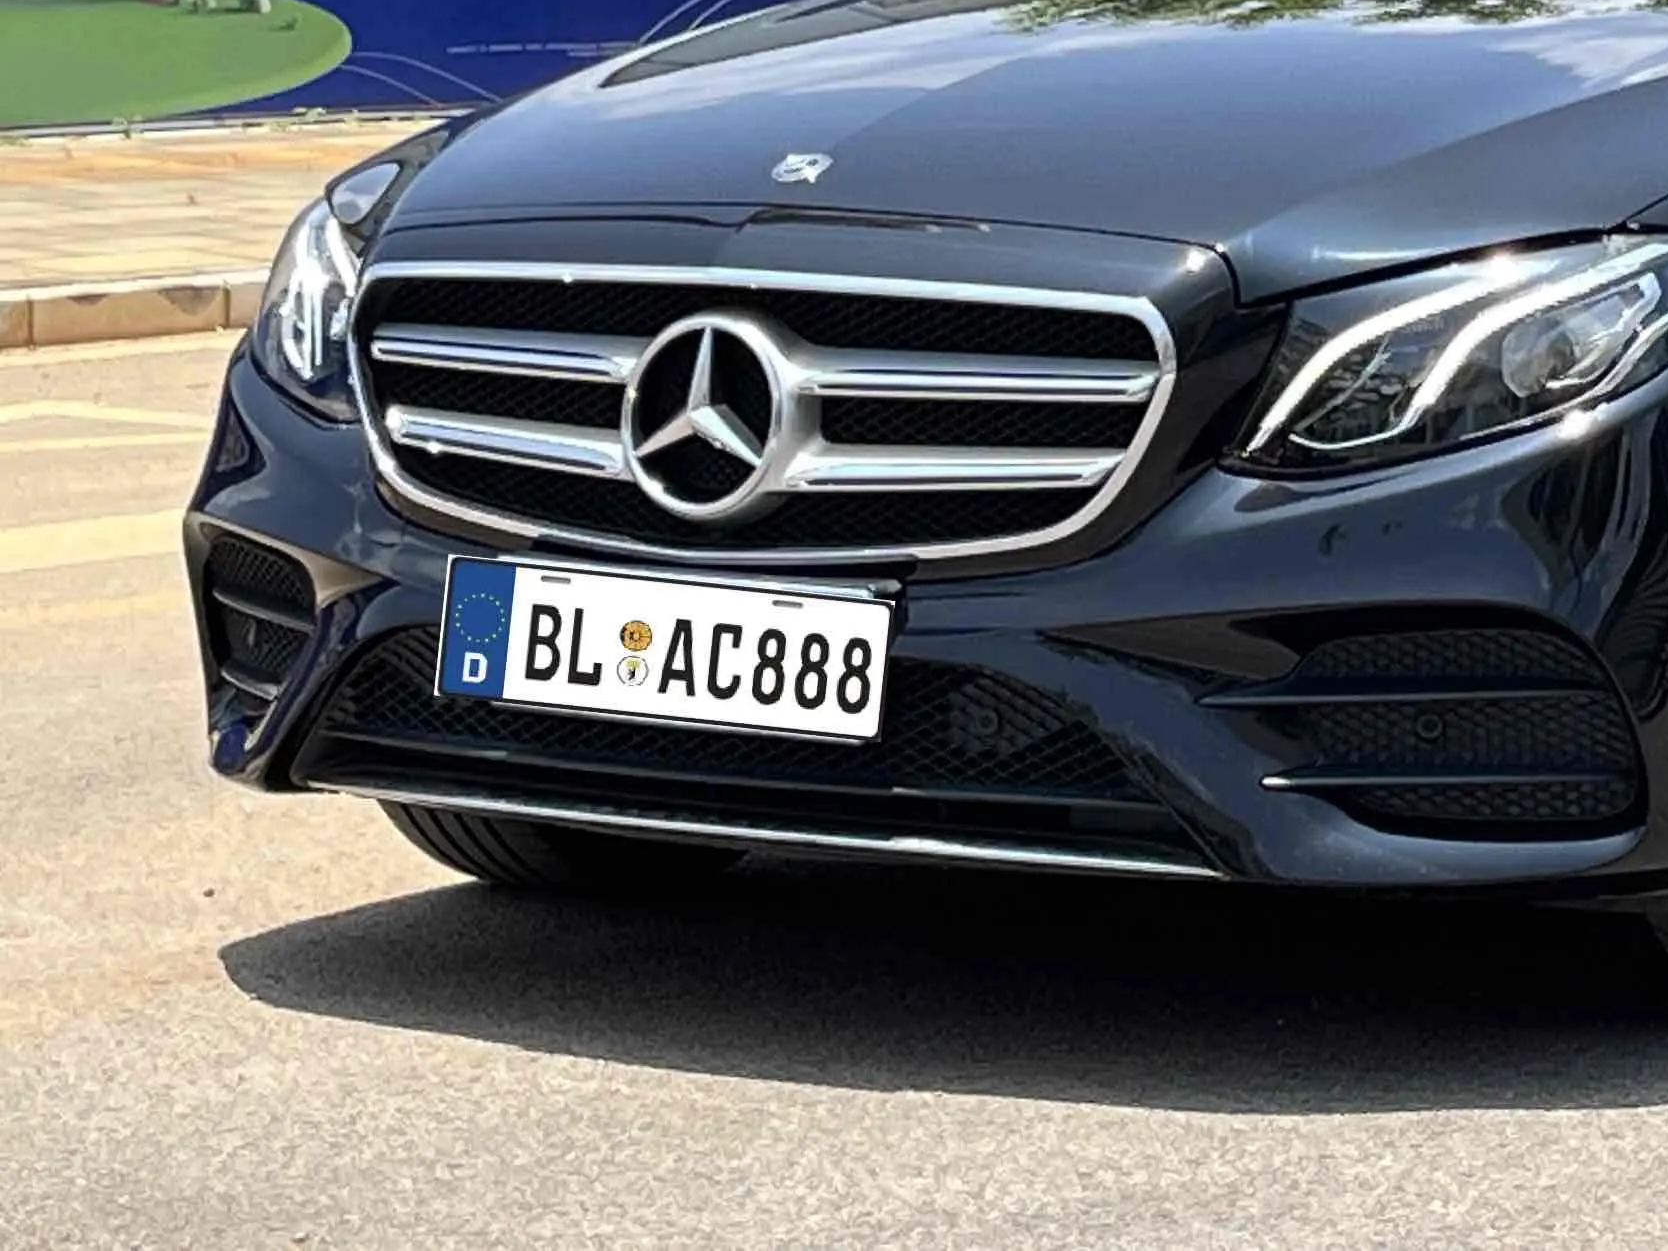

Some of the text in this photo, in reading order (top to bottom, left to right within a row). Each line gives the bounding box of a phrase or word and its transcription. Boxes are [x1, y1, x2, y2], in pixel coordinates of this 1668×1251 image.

[461, 652, 488, 684] D
[524, 603, 872, 714] BL AC888
